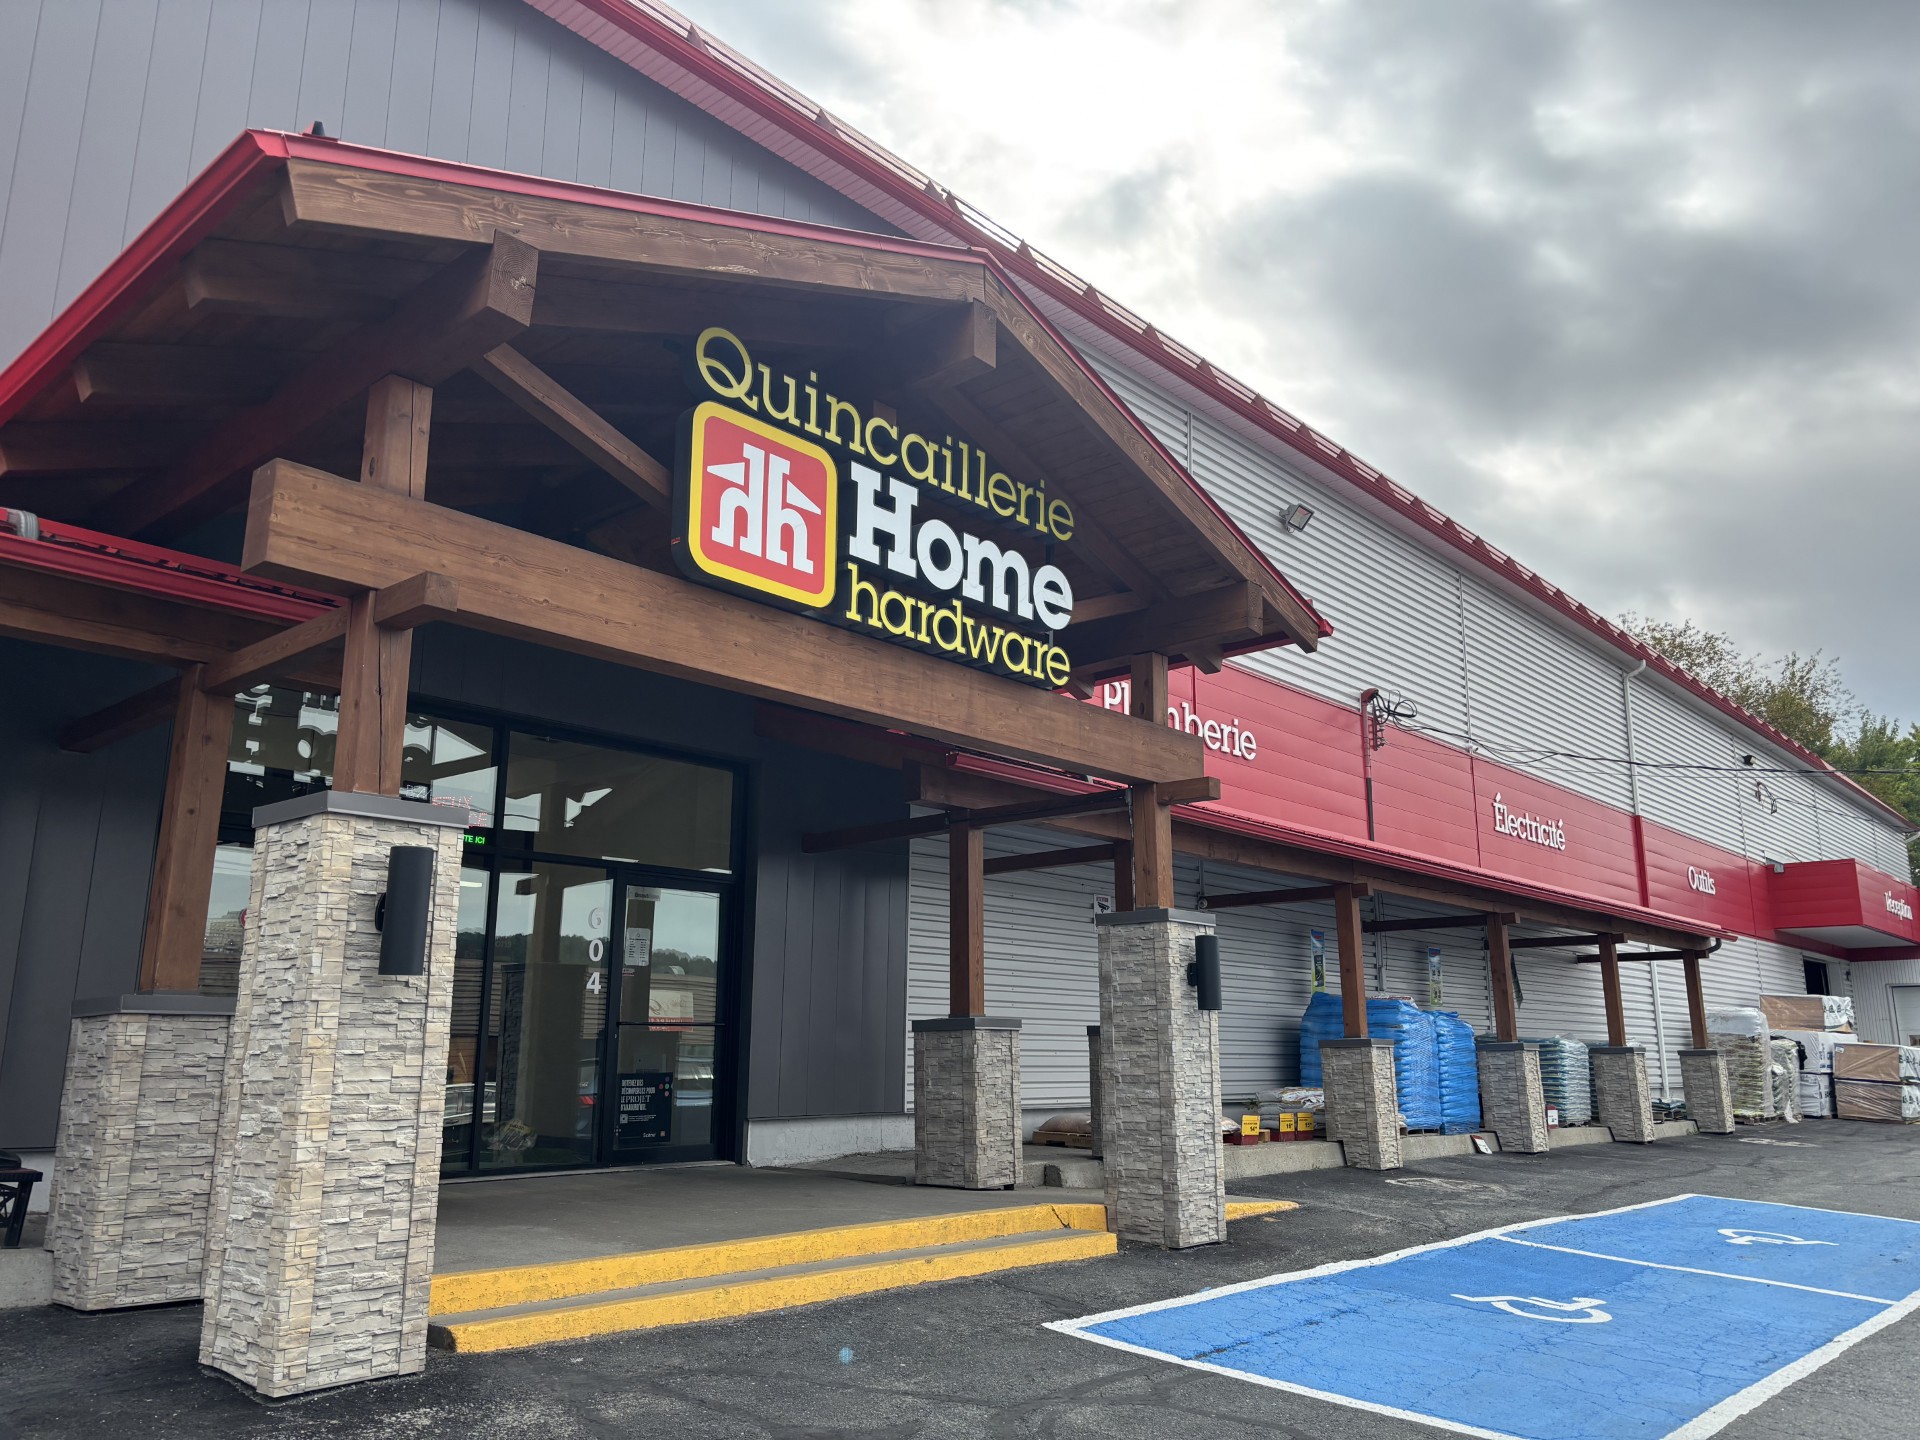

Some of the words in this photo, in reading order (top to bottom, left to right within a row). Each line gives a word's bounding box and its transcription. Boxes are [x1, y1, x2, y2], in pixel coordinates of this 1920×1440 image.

[696, 327, 1075, 541] Quincaillerie
[848, 461, 1073, 630] Home
[845, 563, 1071, 686] hardware
[1103, 681, 1257, 761] Plberie
[1492, 791, 1566, 851] Électricité
[1688, 865, 1716, 895] Outils
